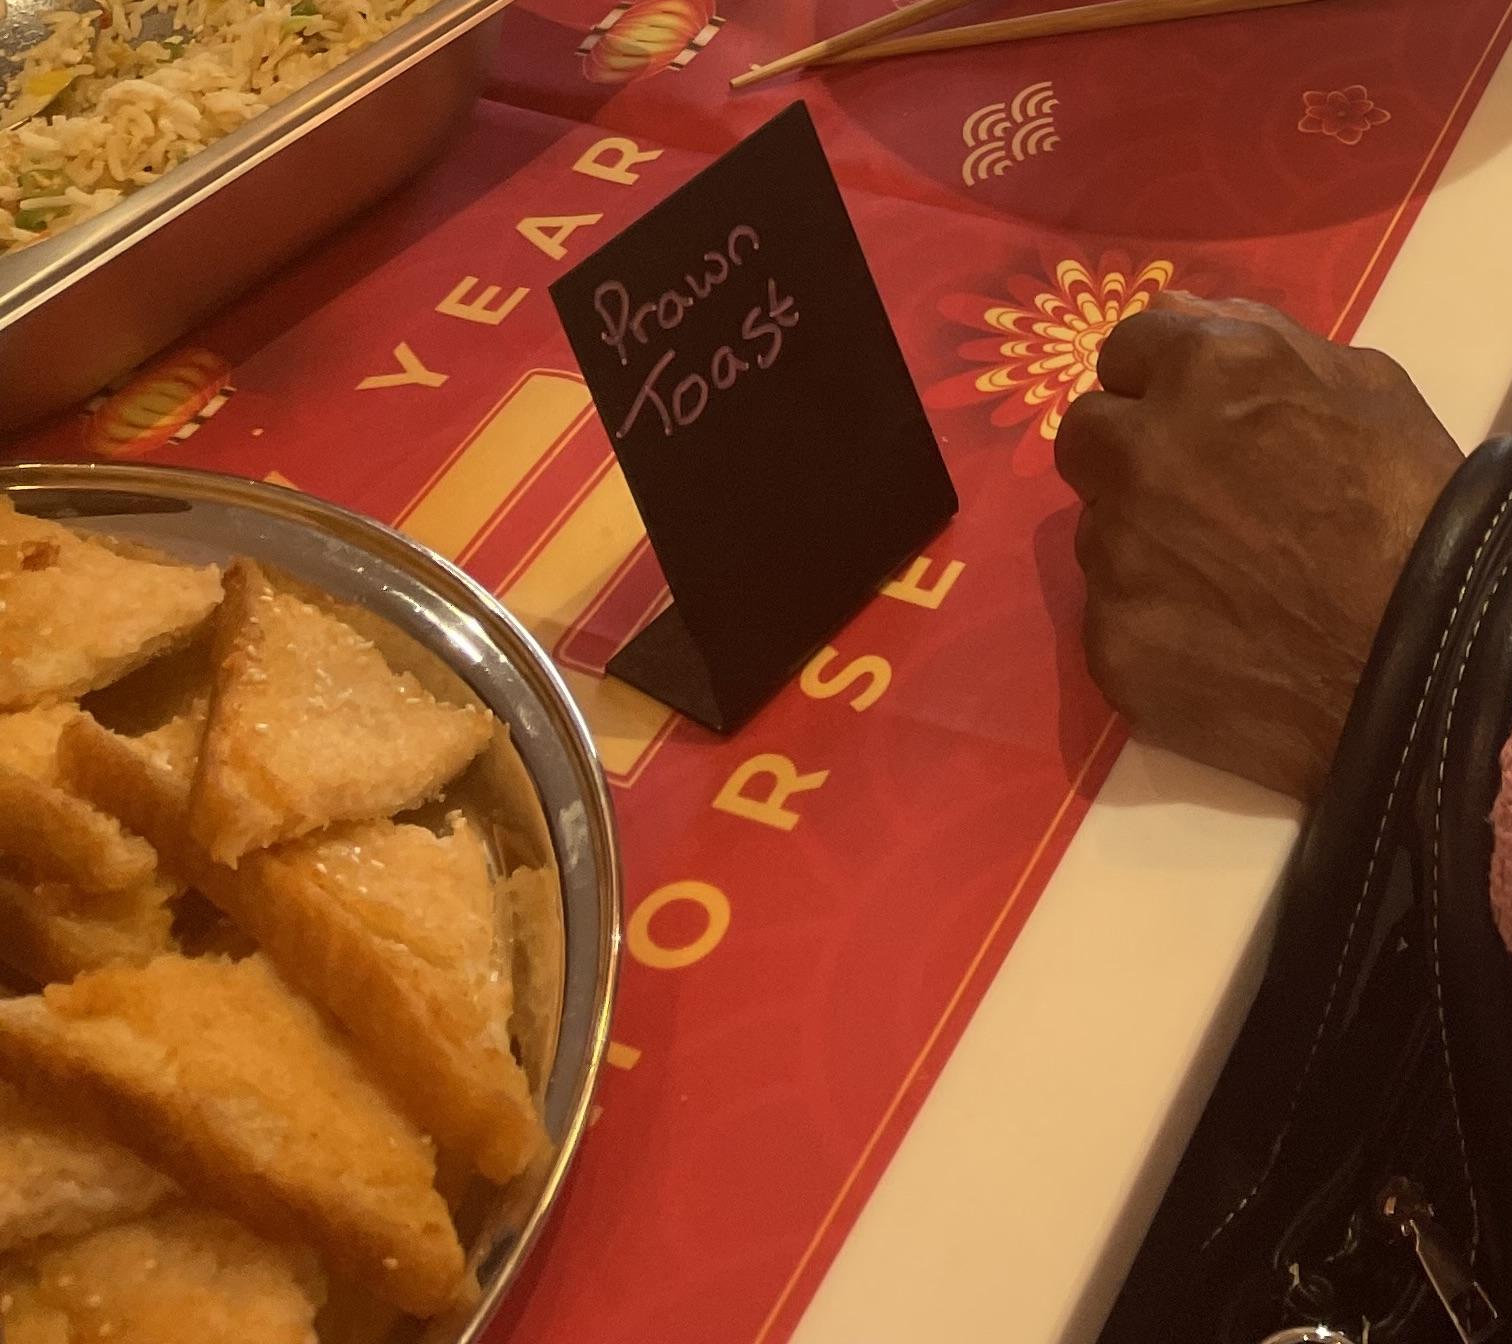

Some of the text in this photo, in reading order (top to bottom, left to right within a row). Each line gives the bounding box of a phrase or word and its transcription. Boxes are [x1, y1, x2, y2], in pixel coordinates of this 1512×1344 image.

[355, 136, 664, 391] YEAR
[592, 224, 760, 365] Prawn
[616, 278, 800, 439] Toast
[606, 555, 967, 1072] ORSE
